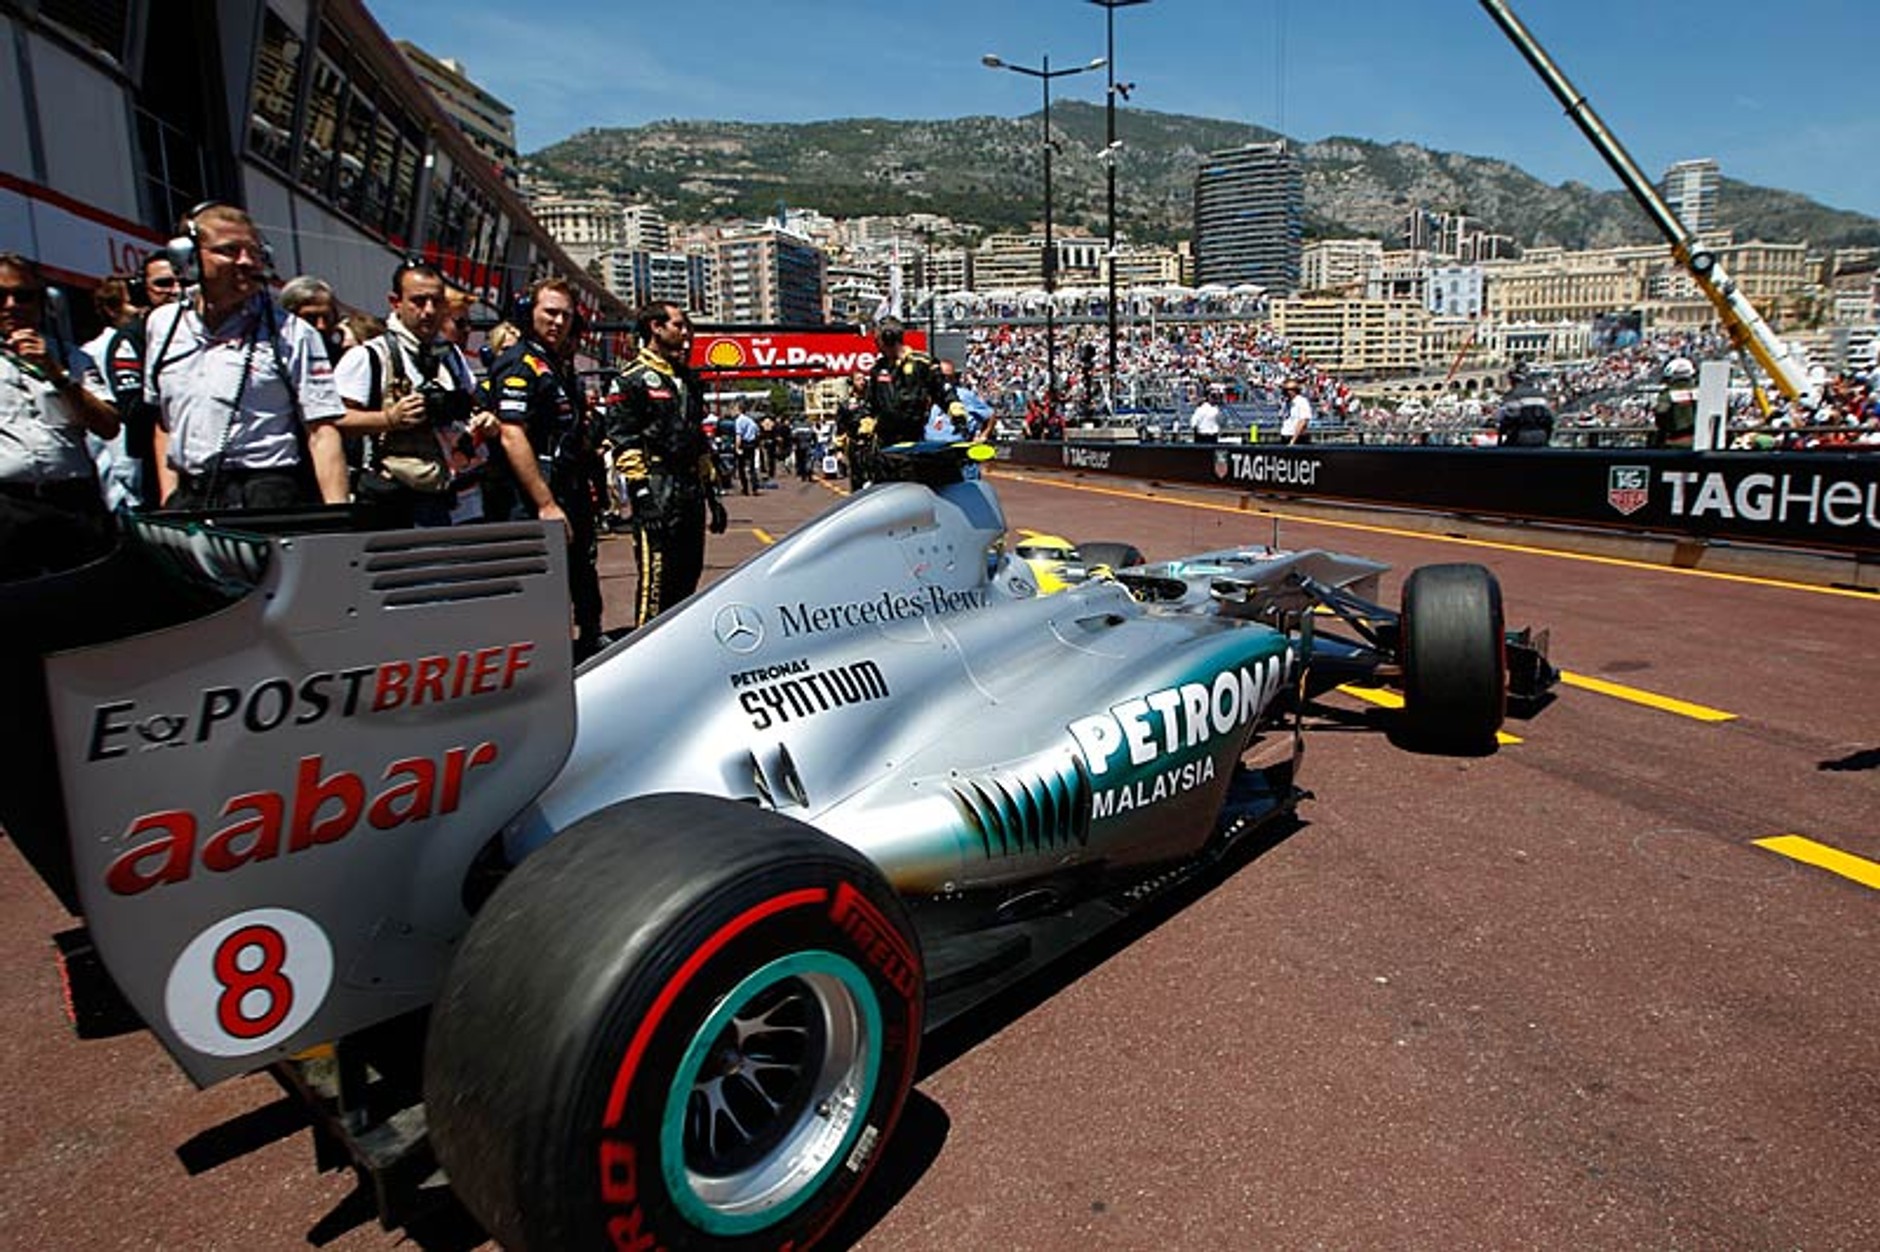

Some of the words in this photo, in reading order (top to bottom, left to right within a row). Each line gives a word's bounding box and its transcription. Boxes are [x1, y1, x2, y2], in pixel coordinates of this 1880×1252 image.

[108, 236, 148, 275] LO
[1231, 453, 1320, 485] TAGHeuer
[730, 658, 810, 688] PETRONAS
[738, 660, 890, 731] SYNTIUM
[105, 740, 498, 896] aabar
[1091, 755, 1215, 820] MALAYSIA
[213, 923, 294, 1040] 8
